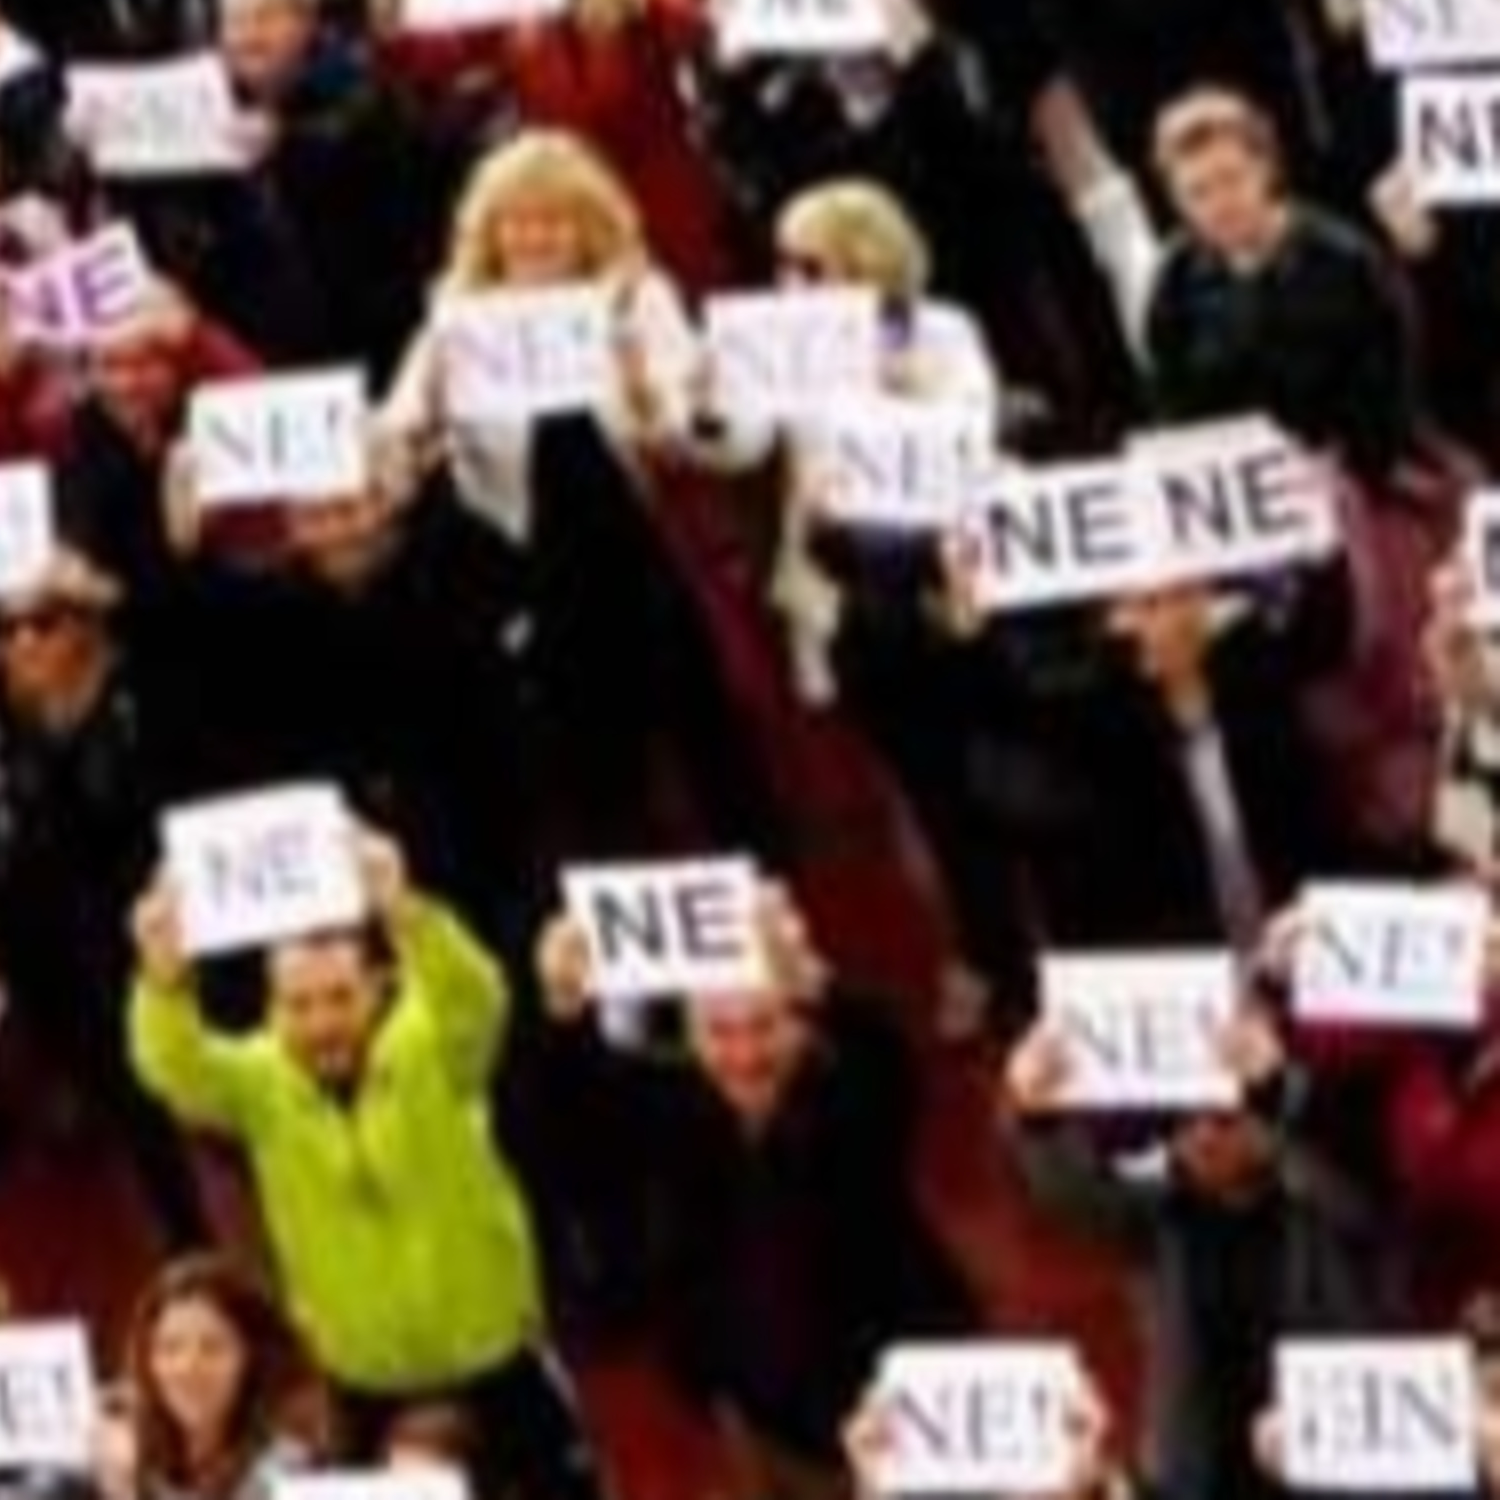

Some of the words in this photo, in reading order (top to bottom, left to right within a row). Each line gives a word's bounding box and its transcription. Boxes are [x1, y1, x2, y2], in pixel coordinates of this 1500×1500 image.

[1419, 102, 1500, 170] N
[14, 250, 142, 332] NE
[988, 484, 1136, 577] NE
[1162, 452, 1307, 546] NE
[208, 822, 318, 904] NE
[588, 880, 745, 965] NE
